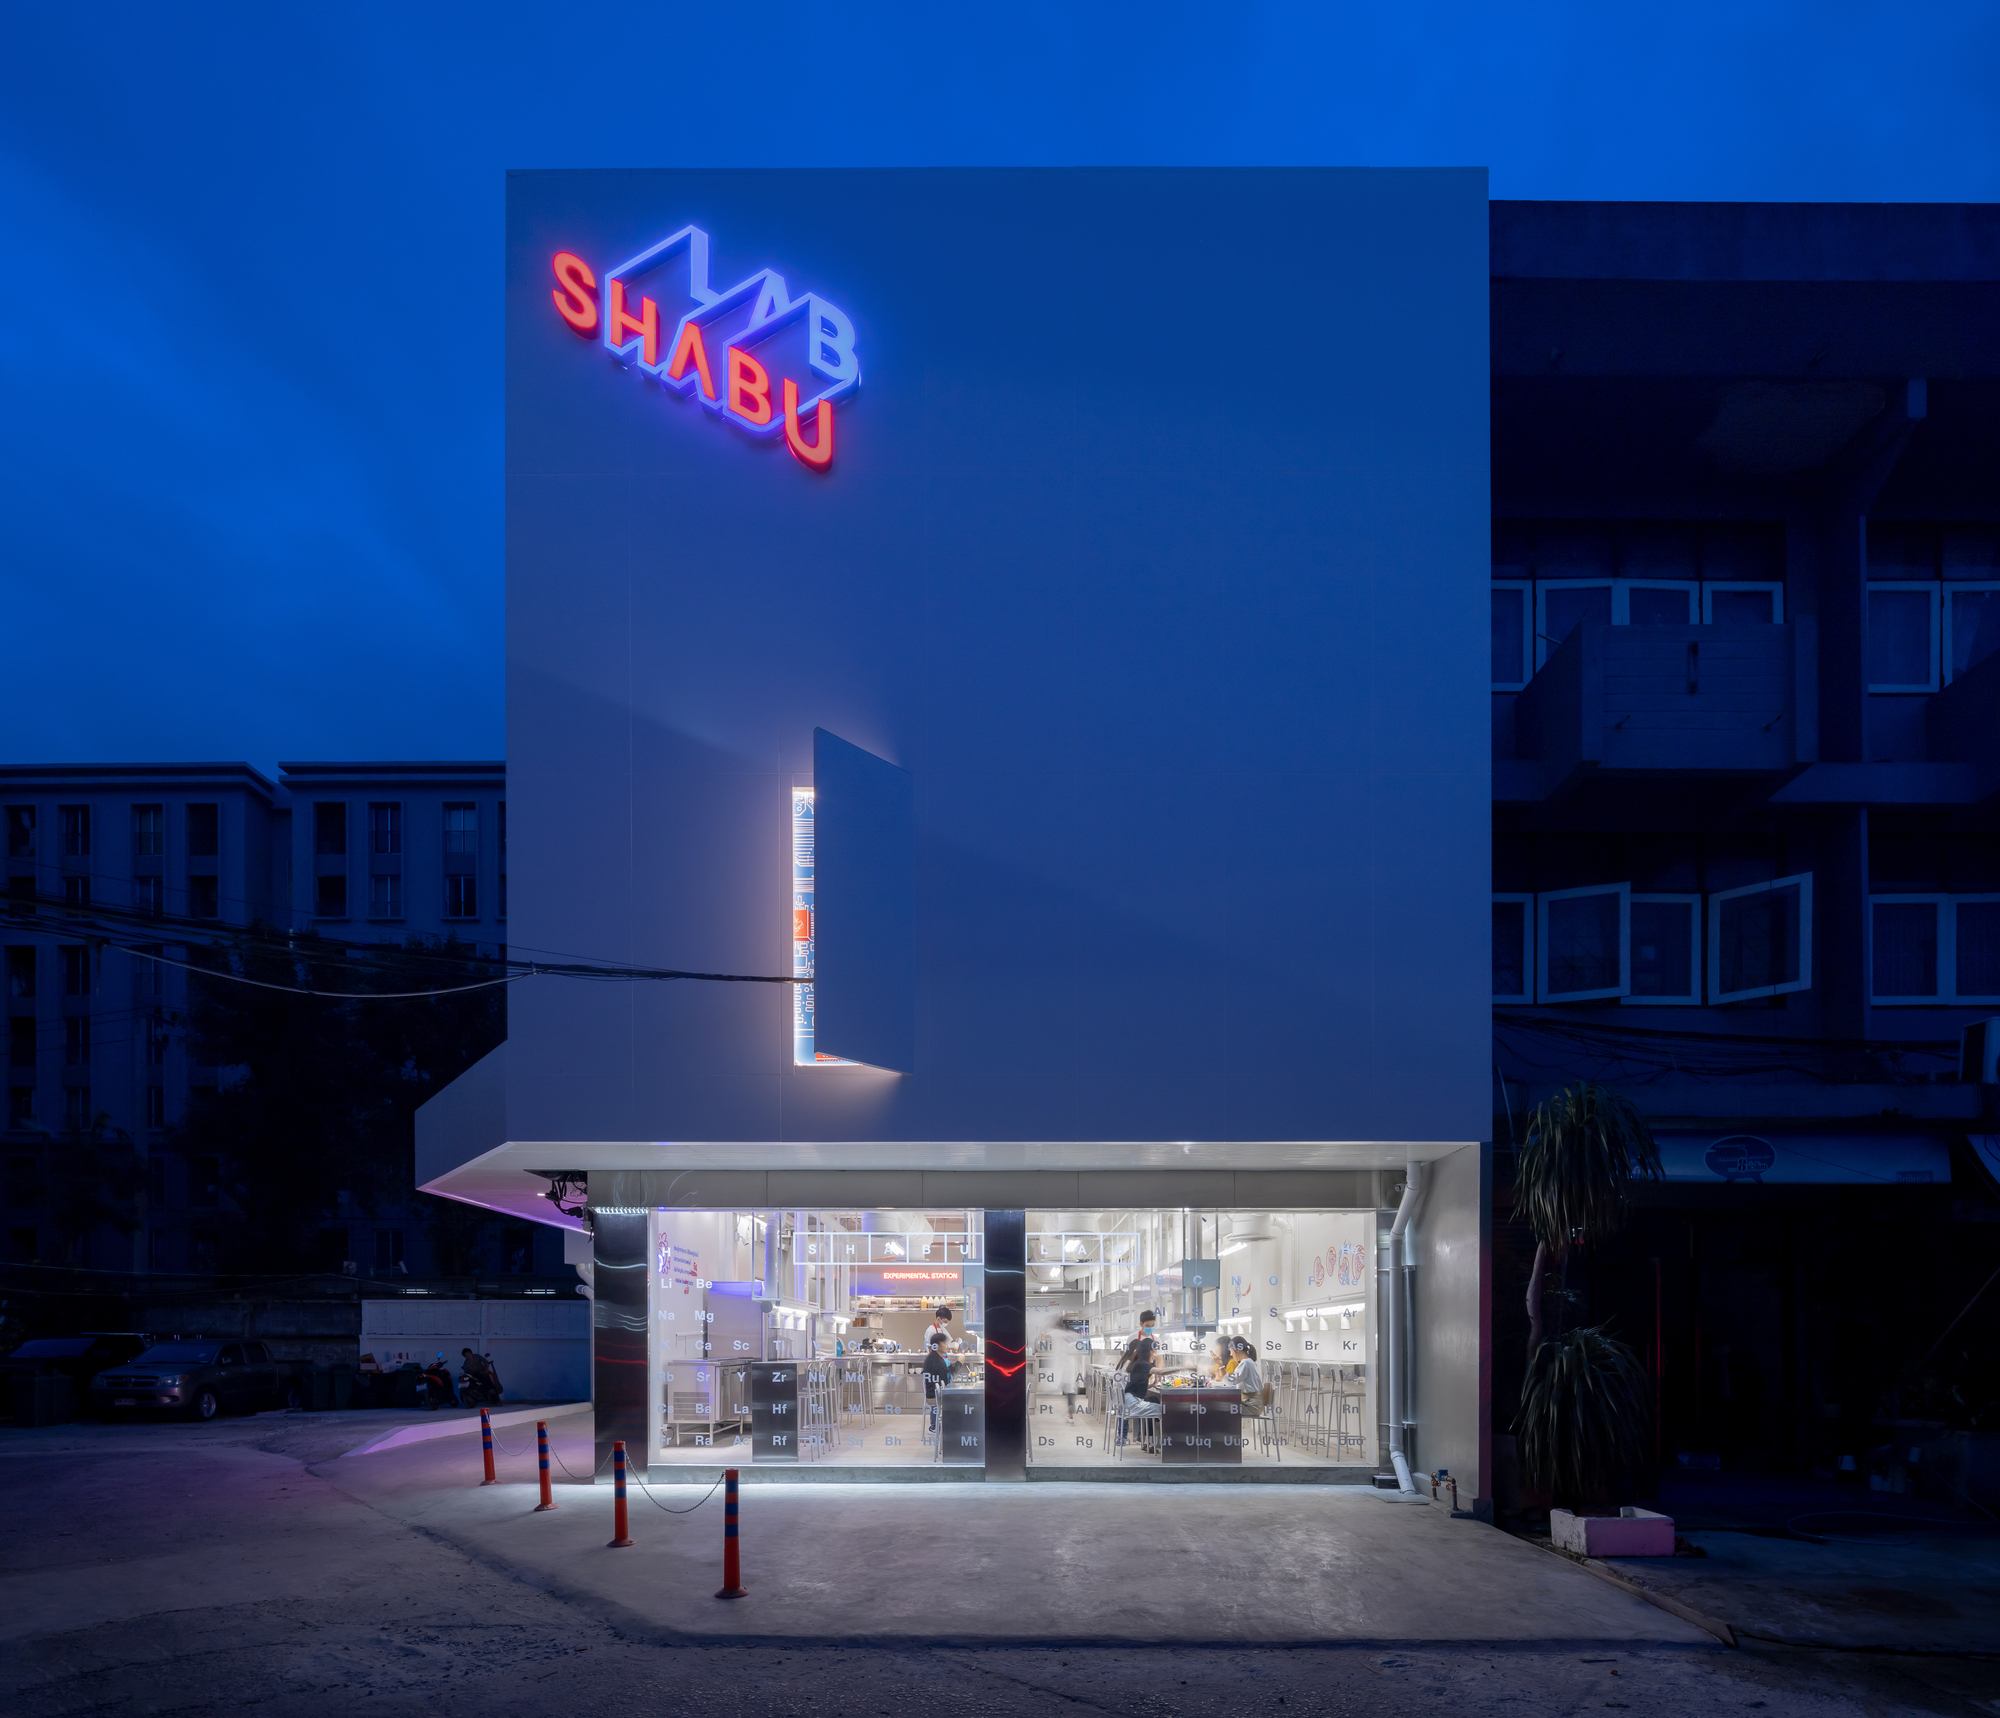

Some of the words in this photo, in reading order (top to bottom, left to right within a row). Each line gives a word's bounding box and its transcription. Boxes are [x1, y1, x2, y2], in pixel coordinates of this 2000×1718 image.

[552, 252, 832, 465] SHABU
[662, 1247, 671, 1256] H
[661, 1279, 672, 1288] Li
[696, 1279, 713, 1288] Be
[1269, 1275, 1278, 1285] O
[1342, 1275, 1358, 1285] Ne
[658, 1310, 675, 1320] Na
[694, 1310, 714, 1322] Mg
[1232, 1307, 1240, 1317] P
[1270, 1307, 1278, 1317] S
[1306, 1307, 1318, 1317] Cl
[1343, 1307, 1357, 1317] Ar
[695, 1340, 712, 1350] Ca
[733, 1340, 749, 1350] Sc
[773, 1340, 784, 1350] Ti
[1040, 1341, 1052, 1350] Ni
[1189, 1341, 1206, 1350] Ge
[1229, 1341, 1244, 1350] As
[1266, 1341, 1282, 1350] Se
[1305, 1341, 1320, 1350] Br
[1343, 1341, 1358, 1350] Kr
[657, 1372, 674, 1382] Rb
[696, 1372, 710, 1382] Sr
[772, 1372, 787, 1382] Zr
[845, 1372, 865, 1382] Mo
[923, 1372, 940, 1382] Ru
[1038, 1373, 1054, 1382] Pd
[1076, 1373, 1093, 1385] Ag
[658, 1404, 674, 1414] Cs
[695, 1404, 712, 1414] Ba
[734, 1404, 749, 1414] La
[772, 1404, 787, 1414] Hf
[885, 1404, 902, 1414] Re
[964, 1404, 974, 1414] Ir
[1040, 1404, 1053, 1414] Pt
[1076, 1404, 1092, 1414] Au
[1190, 1404, 1206, 1414] Pb
[1343, 1404, 1359, 1414] Rn
[695, 1436, 712, 1446] Ra
[733, 1436, 750, 1446] Ac
[773, 1436, 787, 1446] Rf
[885, 1436, 902, 1446] Bh
[961, 1436, 978, 1446] Mt
[1038, 1436, 1055, 1446] Ds
[1076, 1436, 1093, 1448] Rg
